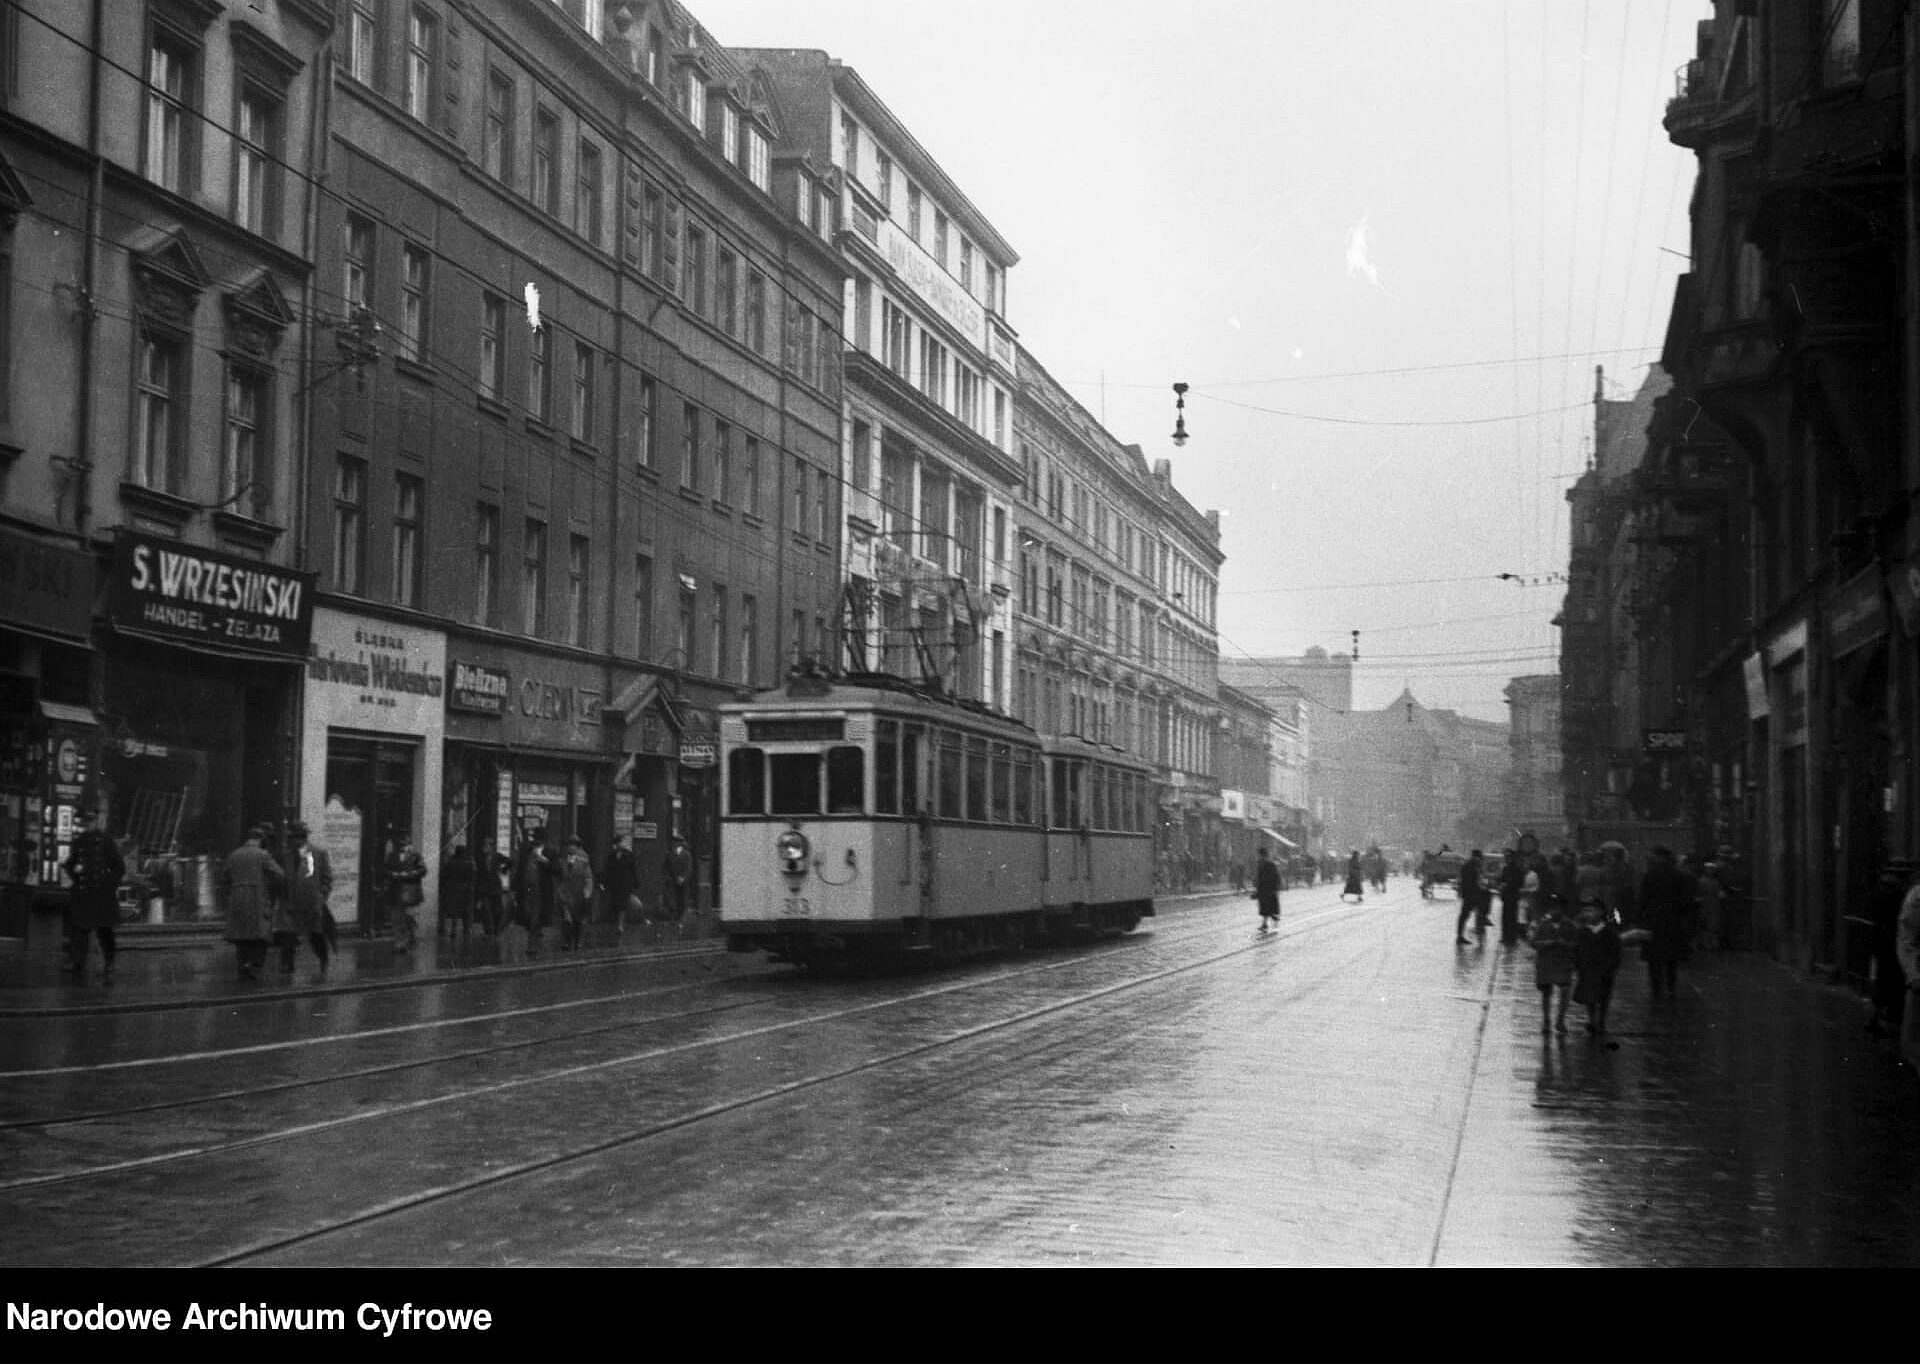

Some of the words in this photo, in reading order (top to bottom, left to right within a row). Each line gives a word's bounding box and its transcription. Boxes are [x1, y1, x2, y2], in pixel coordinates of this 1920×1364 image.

[131, 544, 155, 591] S.
[143, 603, 208, 632] HANDEL
[454, 663, 507, 695] Bielizna
